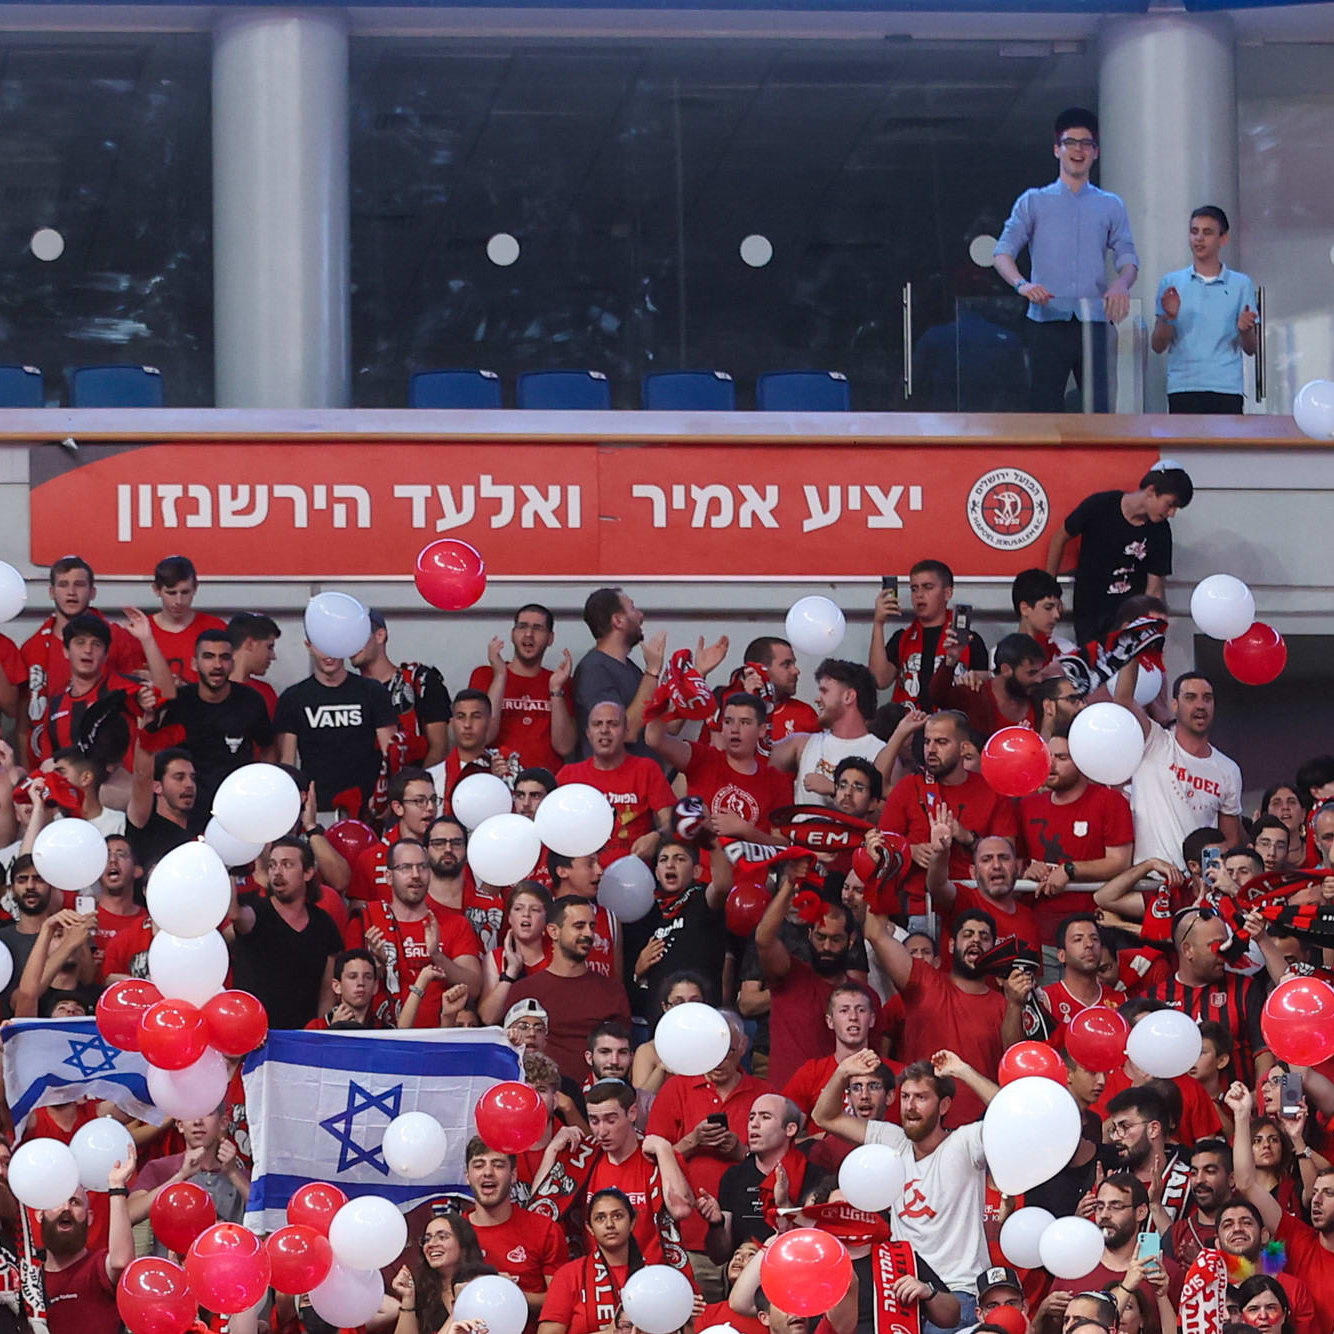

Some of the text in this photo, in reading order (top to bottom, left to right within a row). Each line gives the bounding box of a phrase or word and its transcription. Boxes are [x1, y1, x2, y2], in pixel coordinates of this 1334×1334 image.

[116, 474, 922, 542] יציע אמיר ואלעד הירשנזון
[304, 704, 363, 728] VANS
